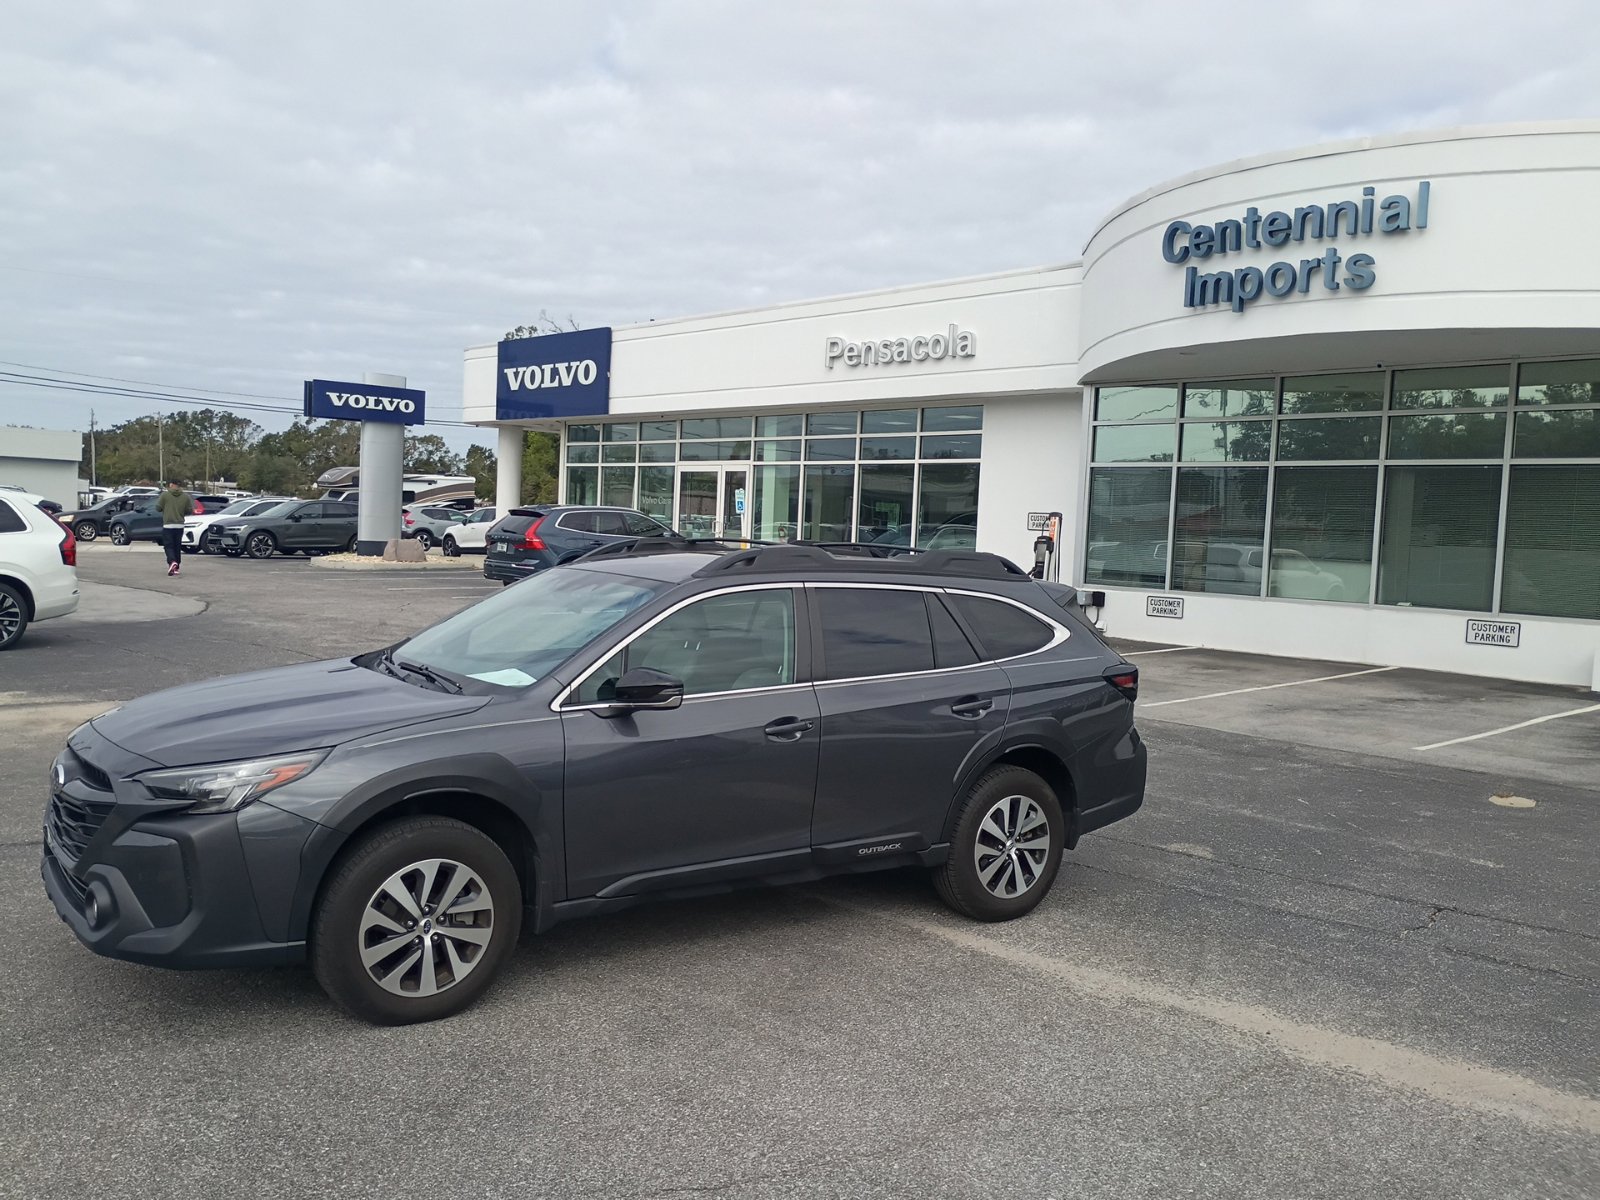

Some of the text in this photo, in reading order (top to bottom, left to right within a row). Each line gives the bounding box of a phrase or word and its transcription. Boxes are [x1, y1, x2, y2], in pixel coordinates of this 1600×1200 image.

[1162, 181, 1430, 264] Centennial
[1184, 247, 1376, 313] Imports
[825, 324, 976, 369] Pensacola
[504, 359, 597, 391] VOLVO
[326, 391, 415, 413] VOLVO
[1150, 598, 1181, 608] CUSTOMER
[1152, 606, 1178, 616] PARKING
[1471, 622, 1516, 634] CUSTOMER
[1474, 632, 1511, 643] PARKING
[858, 843, 901, 855] OUTBACK
